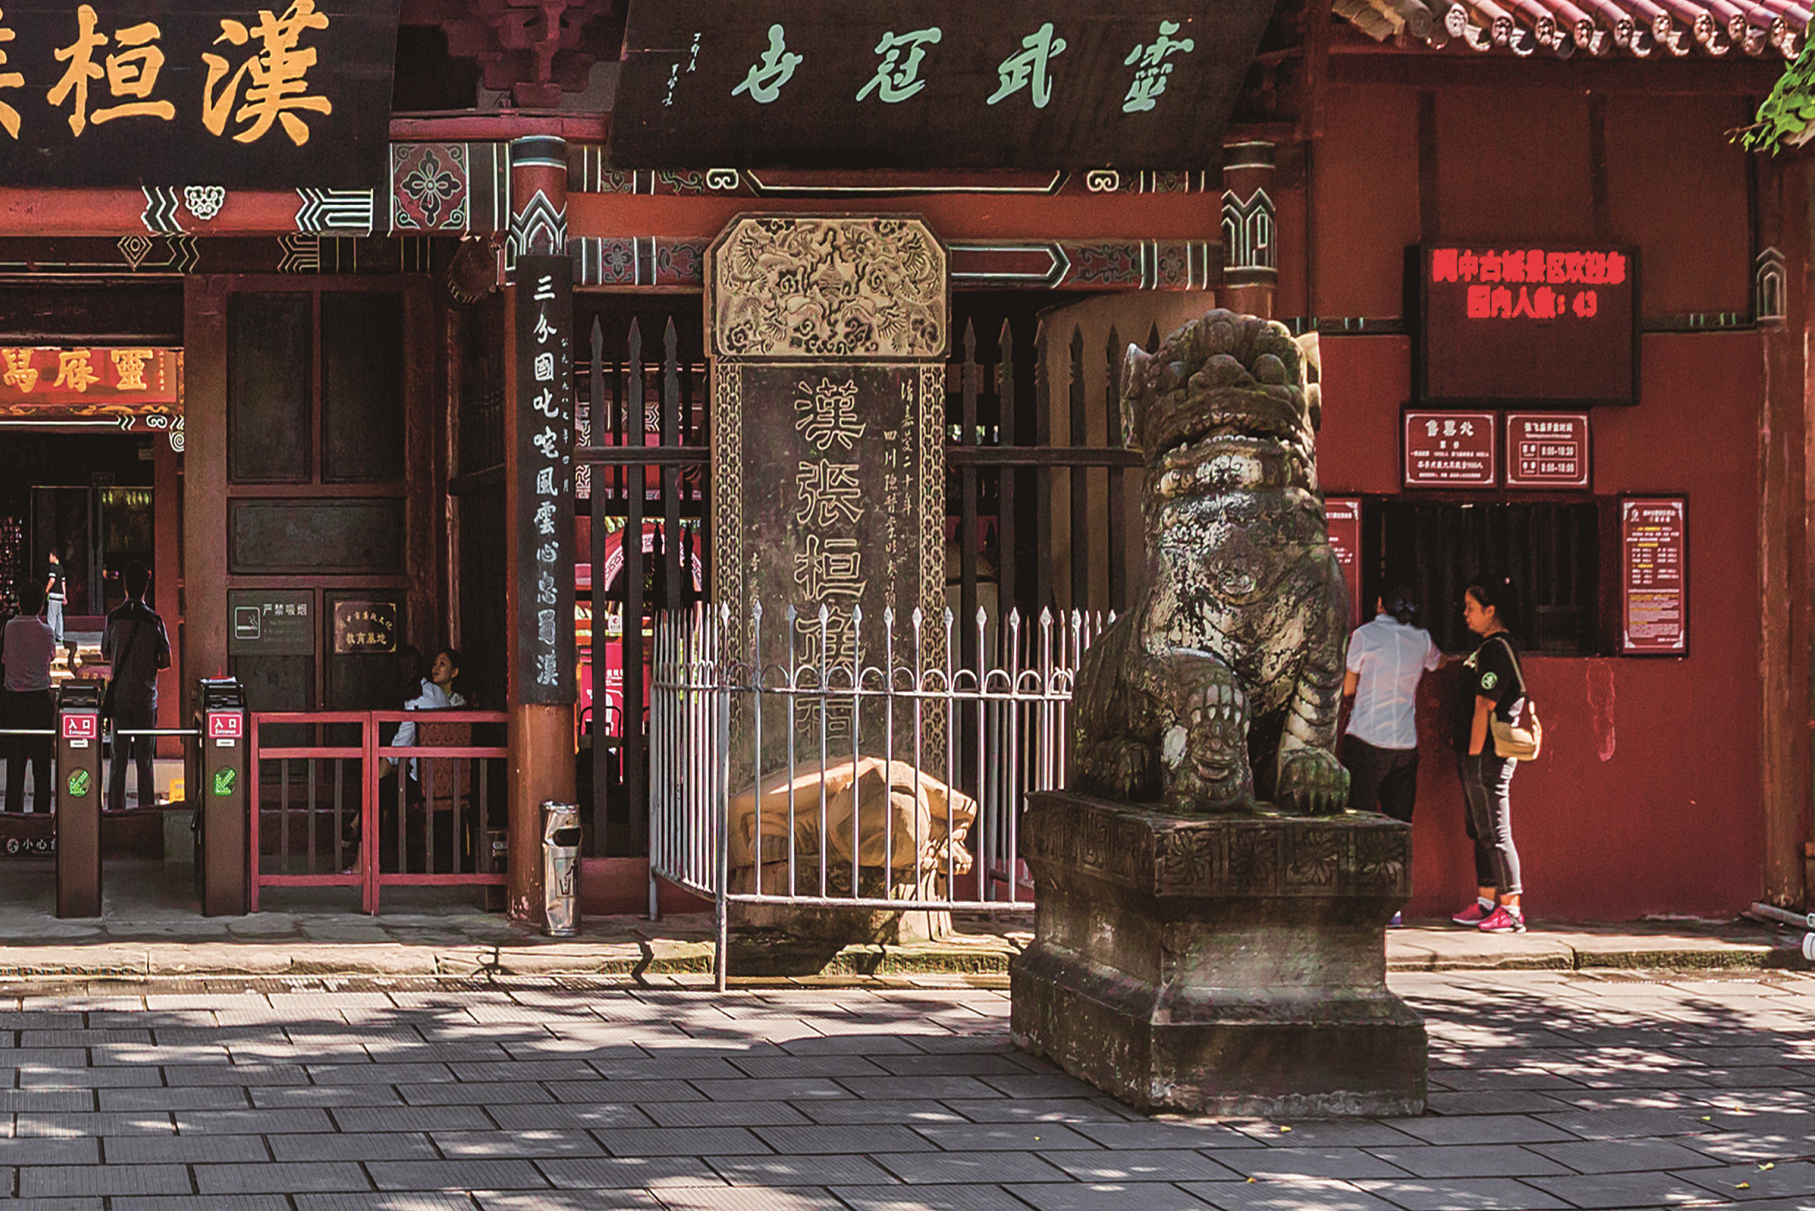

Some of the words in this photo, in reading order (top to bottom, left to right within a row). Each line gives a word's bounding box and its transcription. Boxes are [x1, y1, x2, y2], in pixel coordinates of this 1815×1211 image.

[263, 603, 308, 617] 严禁吸烟
[68, 719, 91, 730] 入口
[214, 718, 237, 729] 入口
